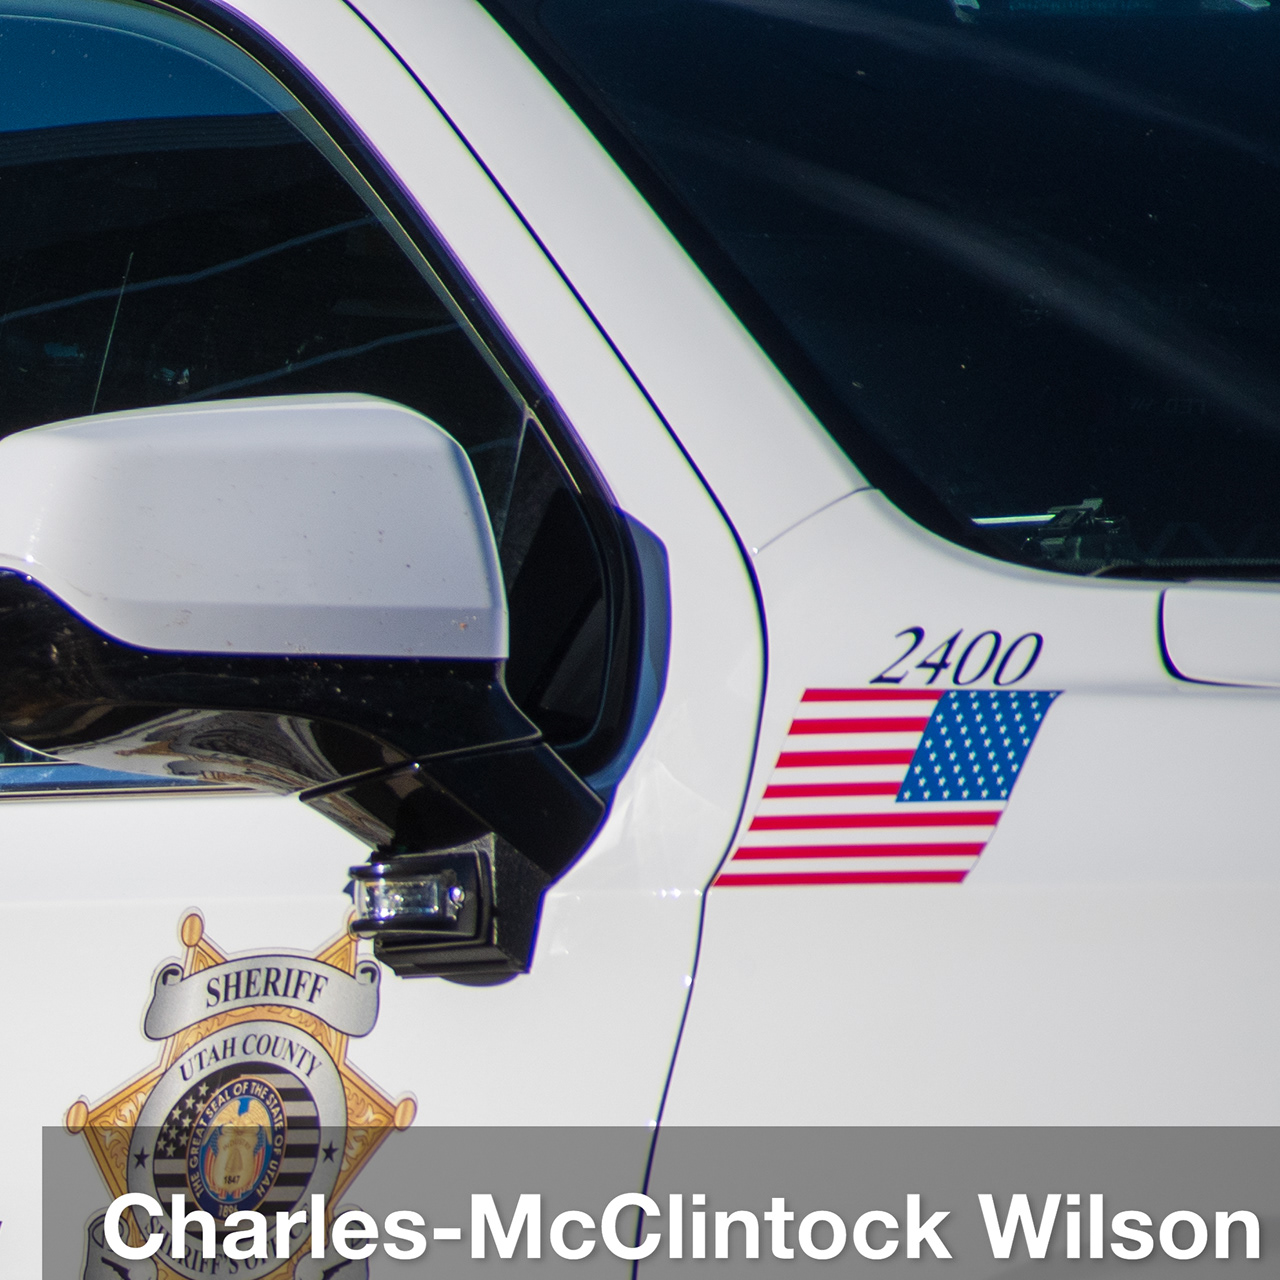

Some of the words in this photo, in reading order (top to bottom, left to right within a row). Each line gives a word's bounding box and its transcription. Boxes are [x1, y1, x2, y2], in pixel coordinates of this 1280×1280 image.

[869, 626, 1044, 687] 2400
[205, 965, 329, 1009] SHERIFF
[178, 1034, 238, 1083] UTAH
[240, 1032, 323, 1080] COUNTY
[205, 1088, 231, 1119] SEAL
[233, 1081, 249, 1096] OF
[249, 1081, 269, 1097] THE
[265, 1093, 285, 1131] STATE
[189, 1117, 208, 1168] GREAT
[273, 1134, 285, 1156] OF
[189, 1171, 206, 1199] THE
[255, 1160, 279, 1198] UTAH
